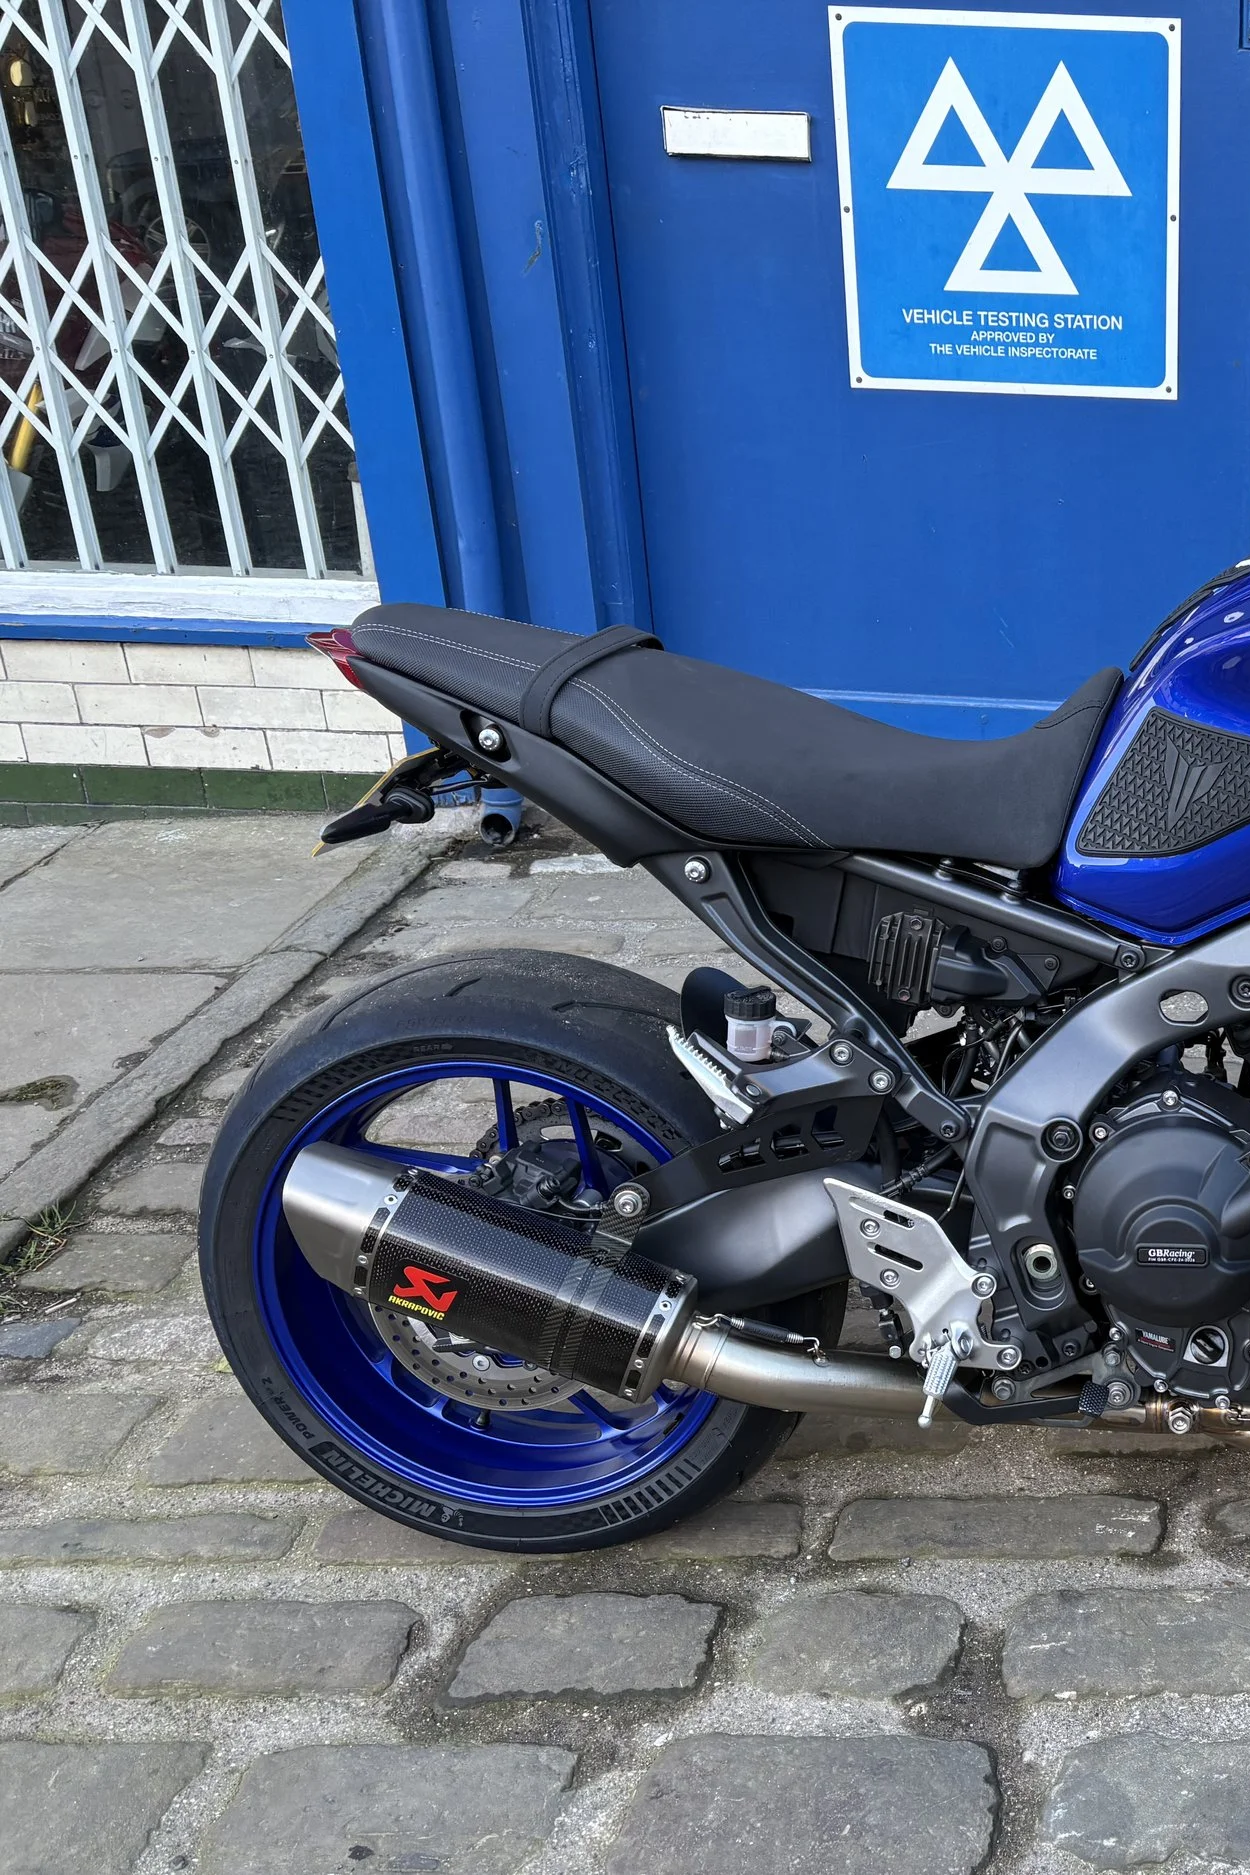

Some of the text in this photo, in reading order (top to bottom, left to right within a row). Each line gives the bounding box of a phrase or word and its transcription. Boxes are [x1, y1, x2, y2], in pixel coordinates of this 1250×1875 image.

[902, 308, 1123, 331] VEHICLE TESTING STATION
[970, 330, 1055, 344] APPROVED BY
[929, 343, 1097, 360] THE VEHICLE INSPECTORATE
[1147, 1247, 1194, 1258] GBRacing
[388, 1295, 445, 1320] AKRAPOVIC
[274, 1395, 315, 1440] POWER
[321, 1449, 436, 1518] MICHELIN
